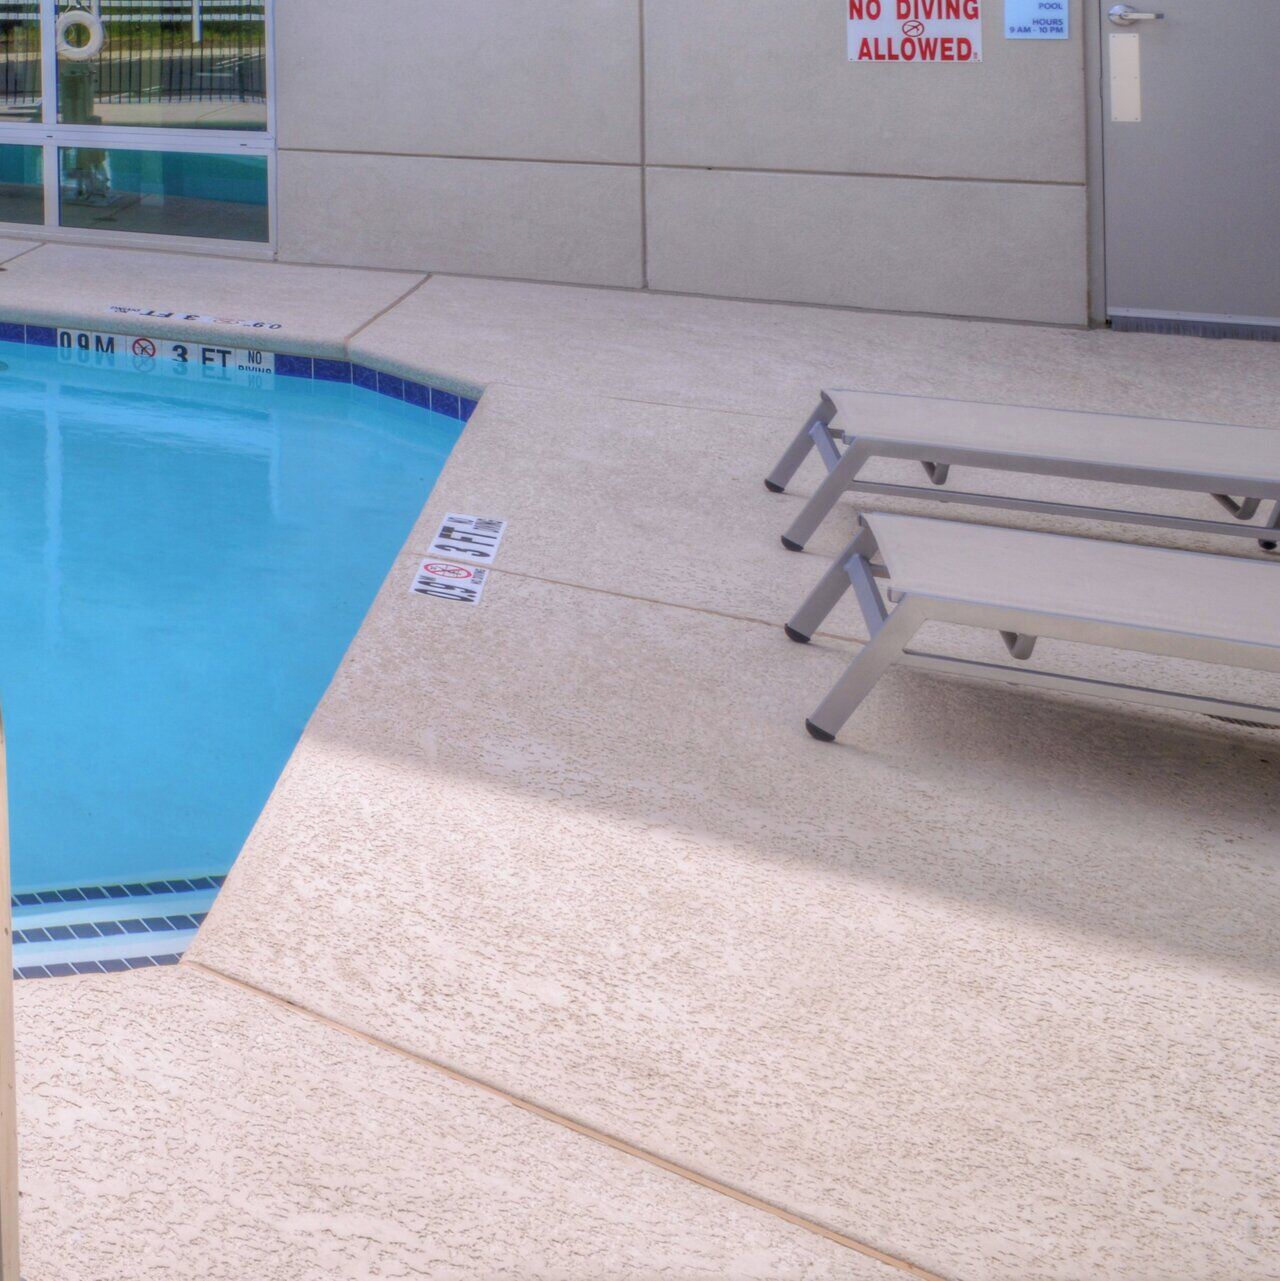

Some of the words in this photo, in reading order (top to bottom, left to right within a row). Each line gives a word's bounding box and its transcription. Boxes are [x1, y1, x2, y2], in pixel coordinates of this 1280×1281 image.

[1038, 2, 1063, 10] POOL
[1032, 18, 1064, 26] HOURS
[858, 37, 972, 61] ALLOWED
[172, 344, 188, 363] 3
[202, 347, 232, 368] FT
[248, 350, 262, 365] NO
[438, 526, 498, 547] FT
[434, 544, 491, 558] 3
